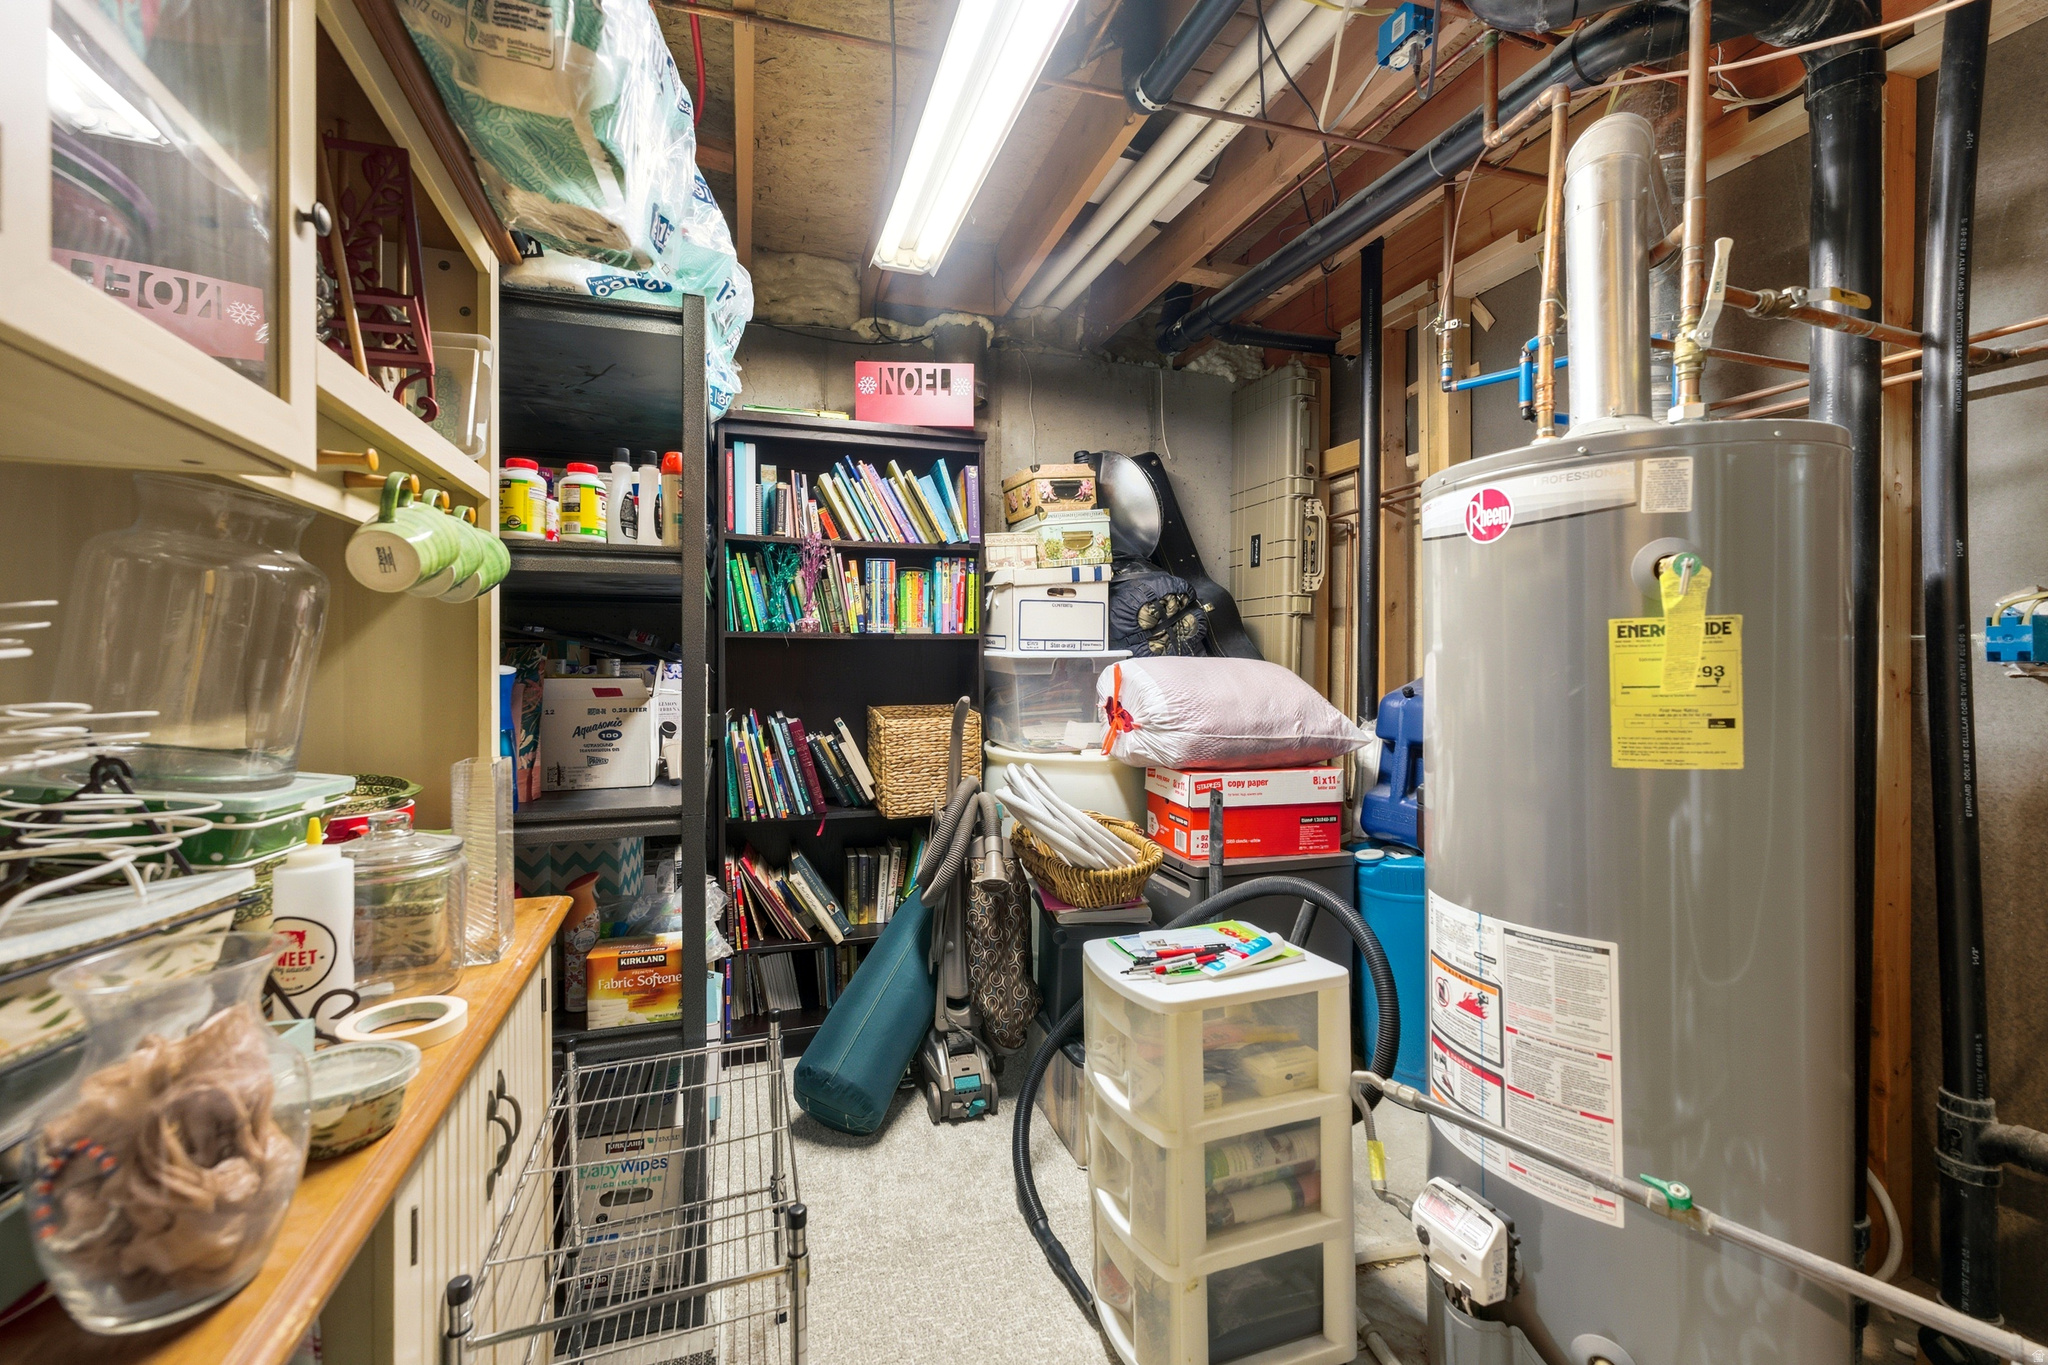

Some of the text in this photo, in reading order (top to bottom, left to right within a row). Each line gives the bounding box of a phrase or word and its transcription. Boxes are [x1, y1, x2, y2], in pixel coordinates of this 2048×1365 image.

[879, 367, 952, 396] NOEL
[1469, 488, 1510, 535] Rheem
[572, 720, 623, 739] Aquasonic
[1196, 781, 1221, 791] STAPLES
[1247, 779, 1269, 787] paper
[620, 955, 665, 966] KIRKLAND
[598, 976, 634, 990] Fabric
